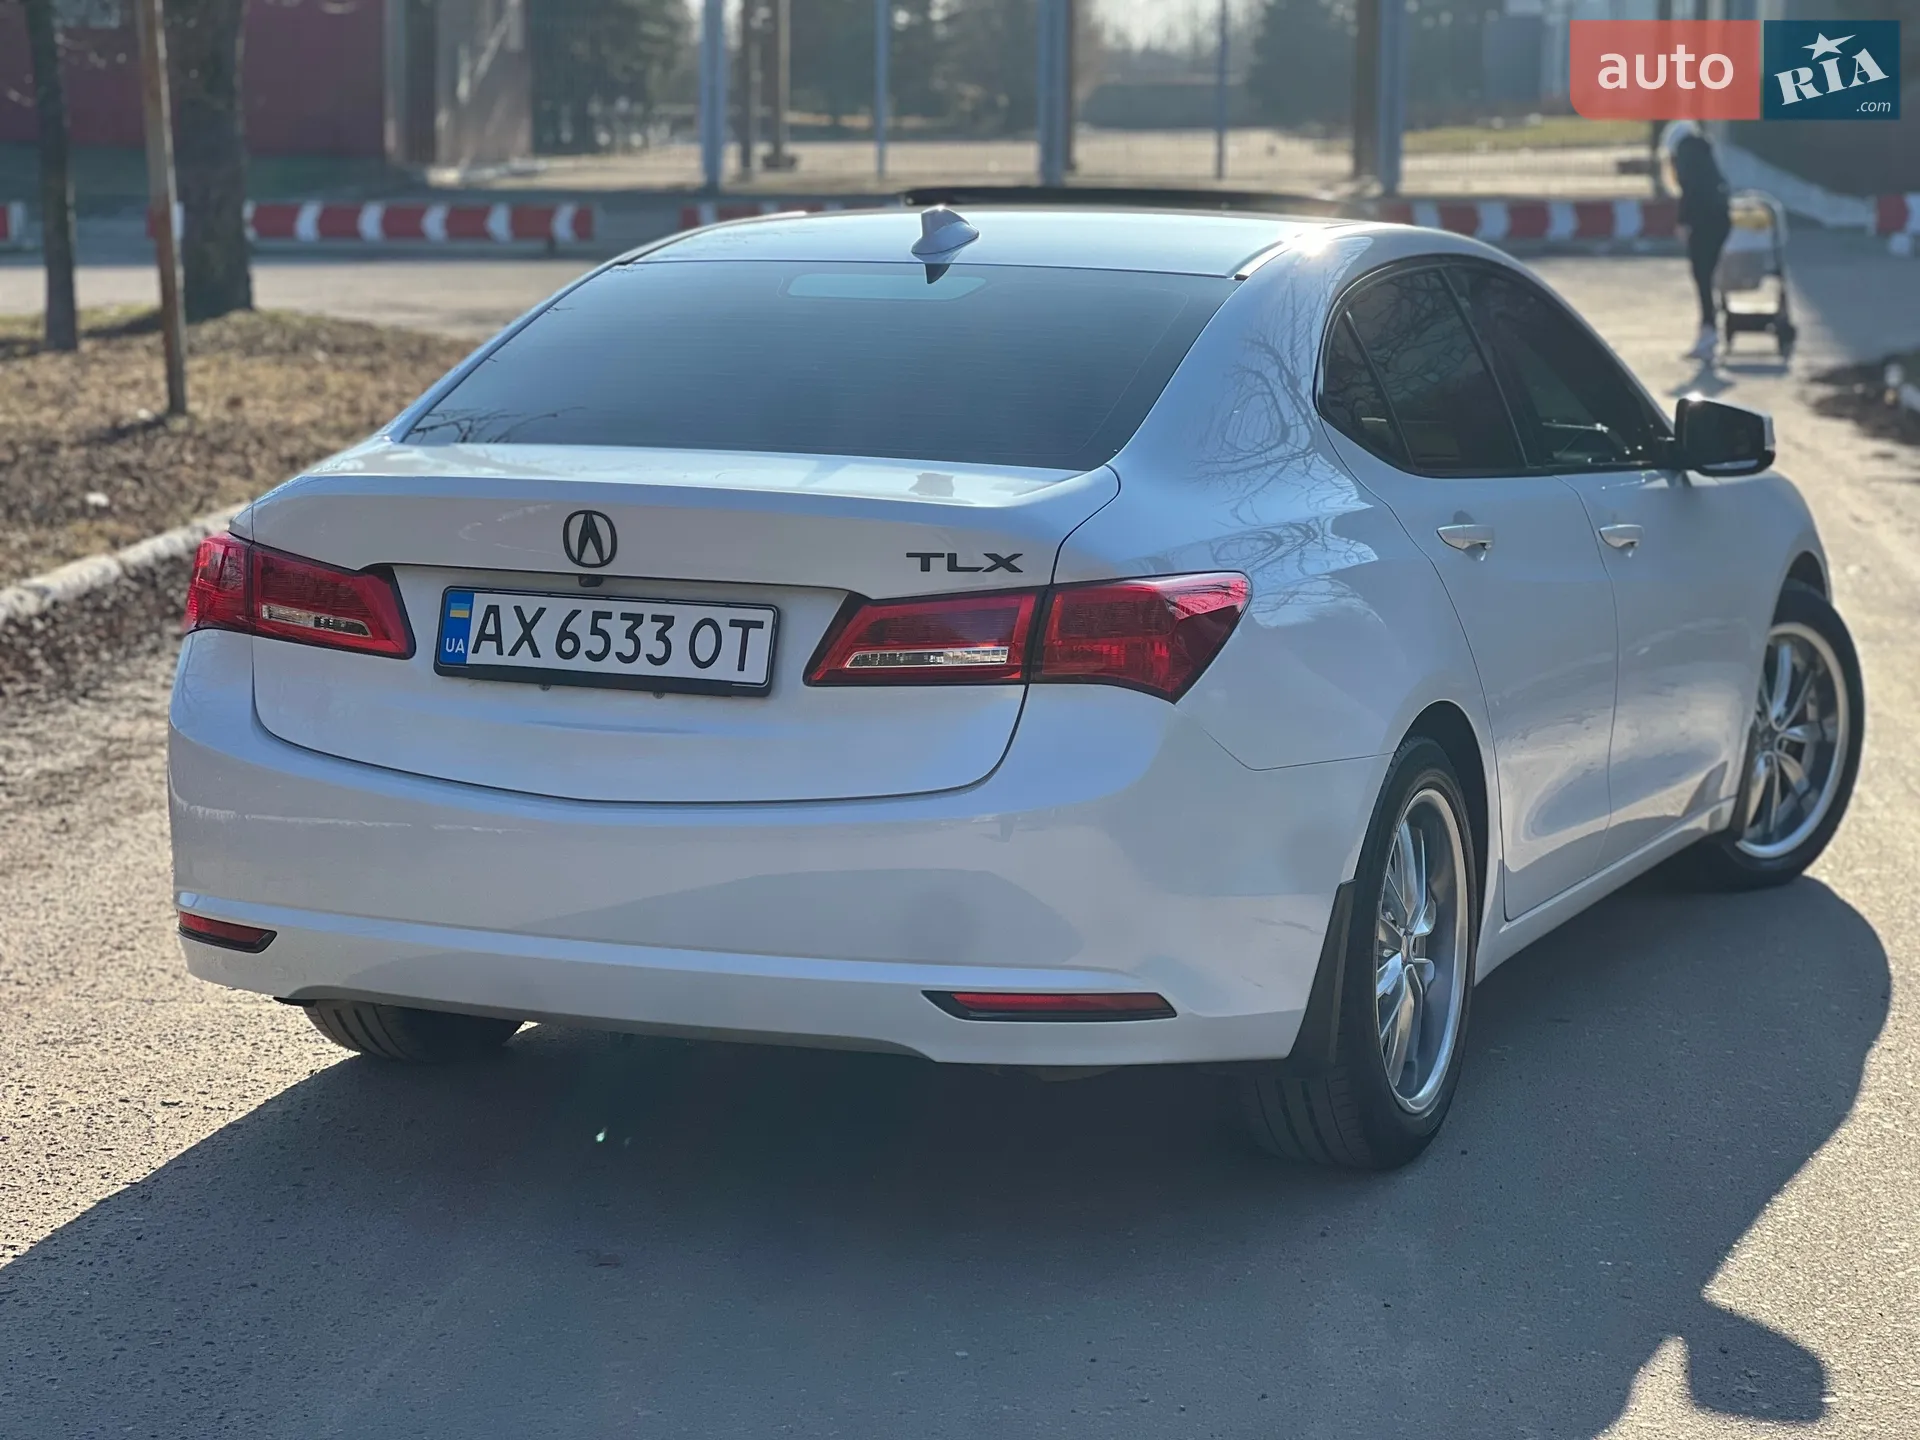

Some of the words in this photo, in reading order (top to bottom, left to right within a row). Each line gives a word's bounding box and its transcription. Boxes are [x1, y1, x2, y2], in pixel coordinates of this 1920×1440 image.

[906, 552, 1023, 572] TLX
[446, 638, 465, 654] UA
[471, 604, 546, 658] AX
[555, 609, 674, 666] 6533
[688, 617, 764, 671] OT
